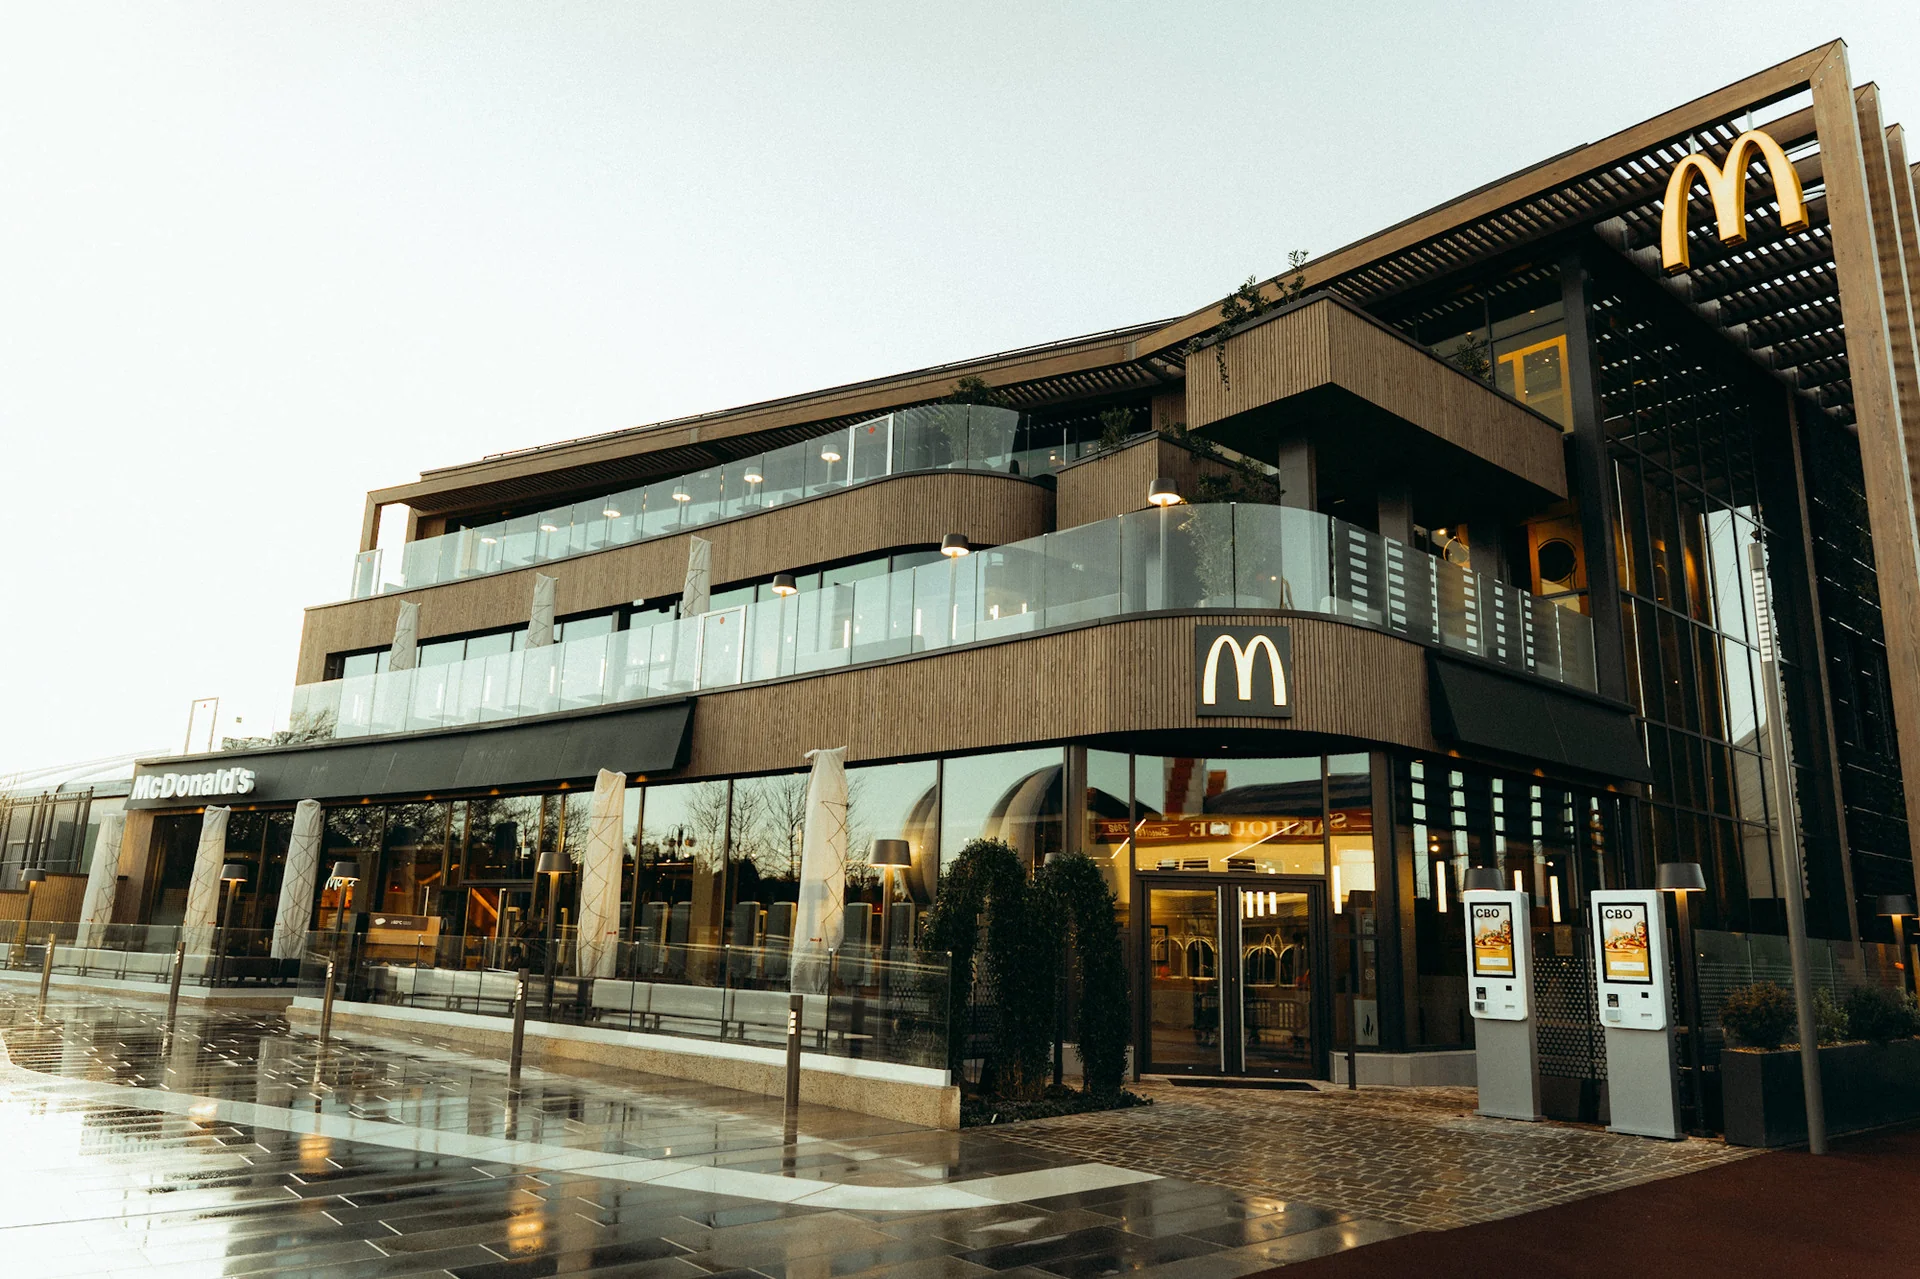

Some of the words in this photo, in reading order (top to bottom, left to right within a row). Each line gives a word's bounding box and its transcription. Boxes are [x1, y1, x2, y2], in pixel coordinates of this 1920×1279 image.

[131, 767, 255, 800] McDonald's
[1476, 908, 1500, 918] CBO
[1605, 909, 1633, 919] CBO
